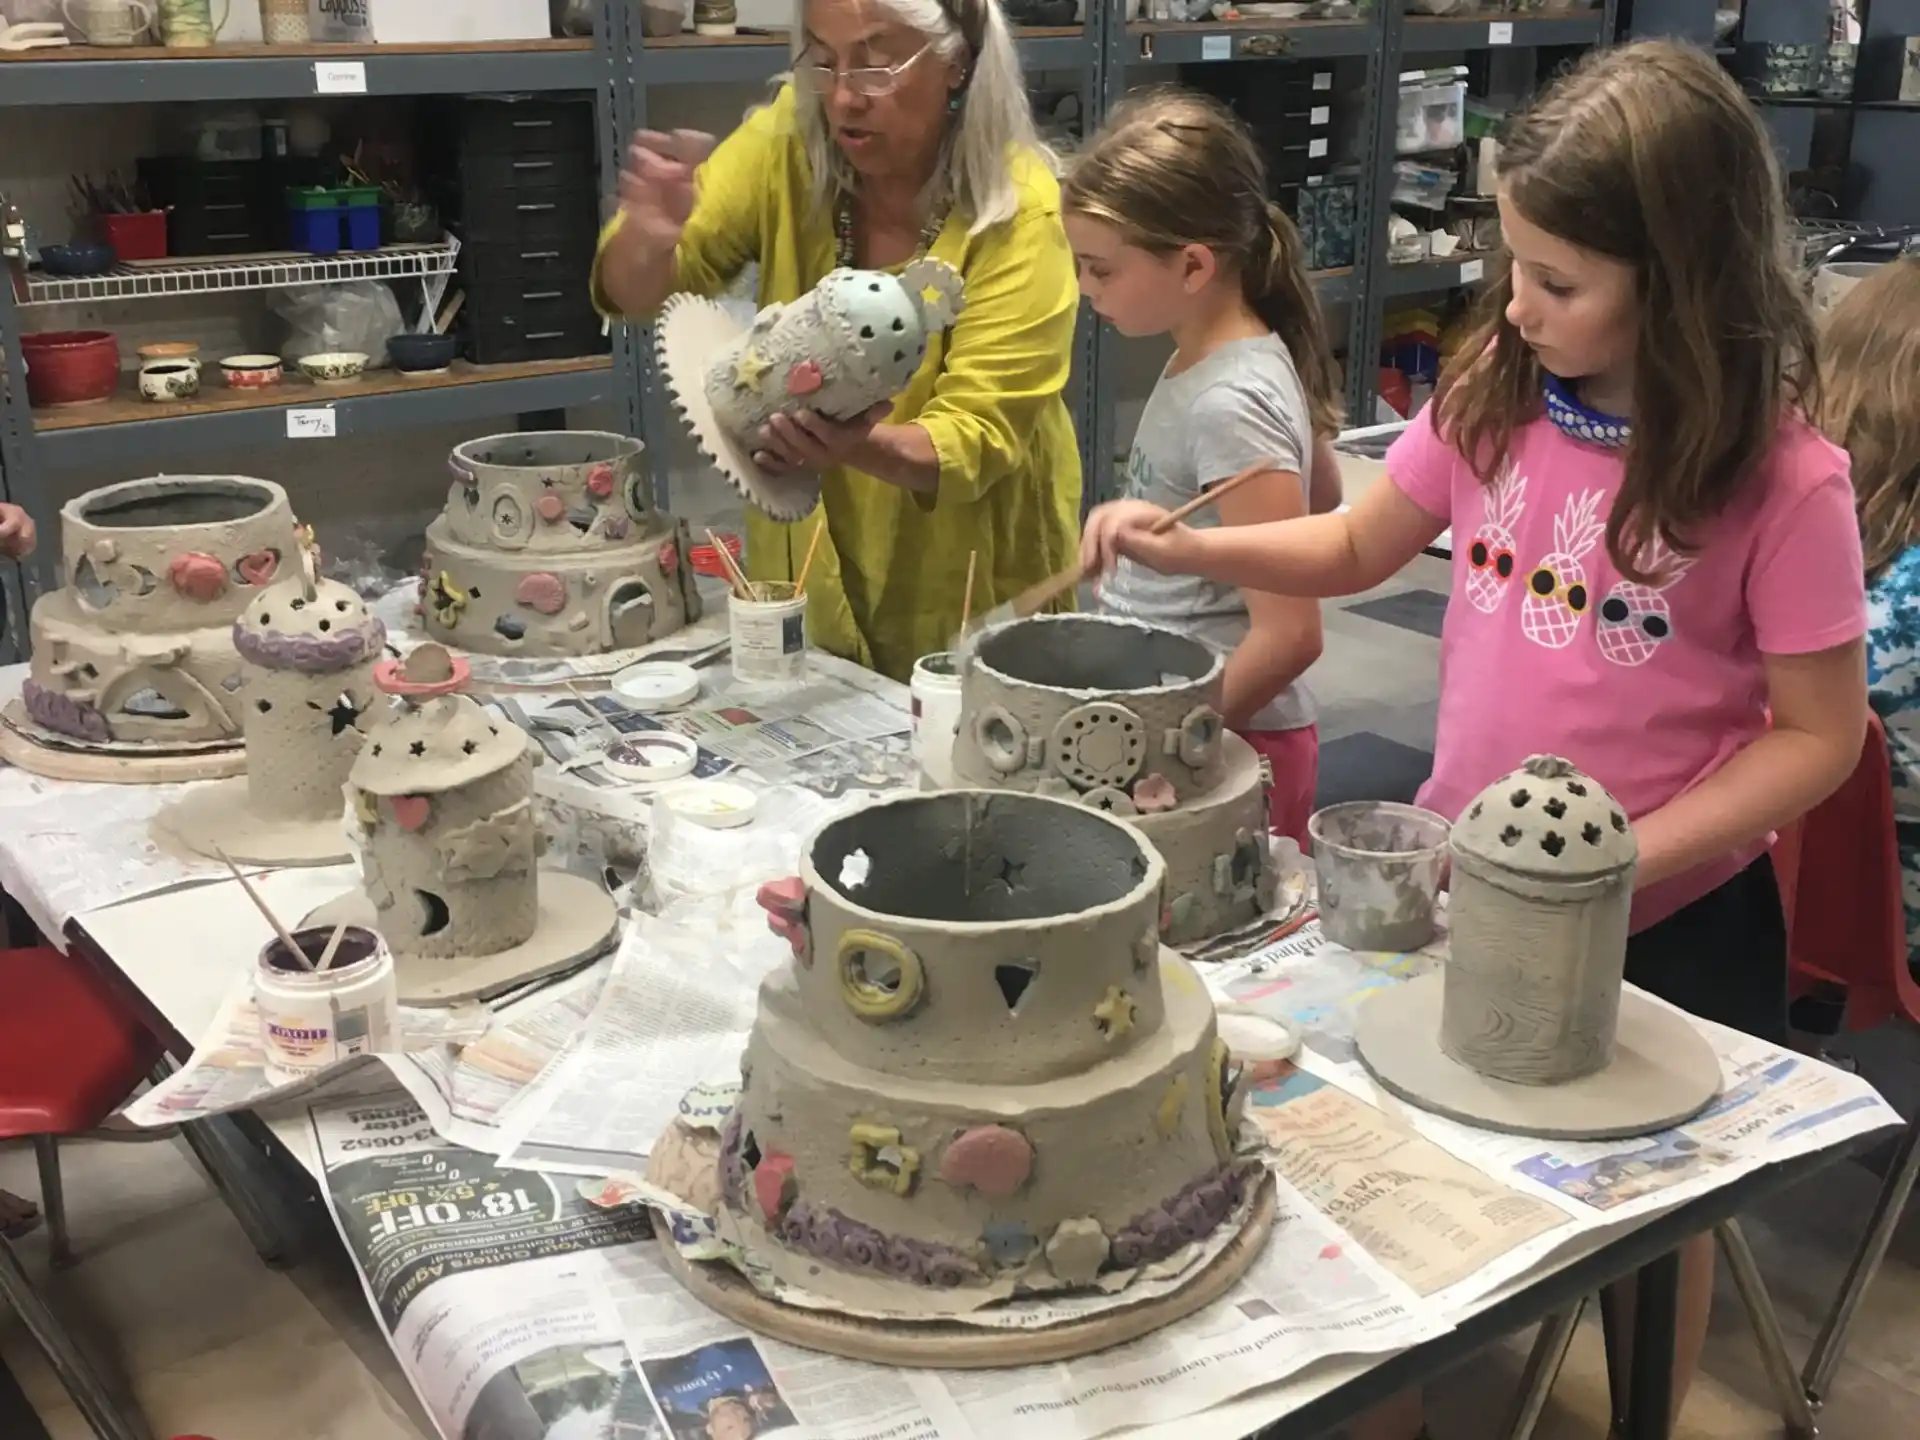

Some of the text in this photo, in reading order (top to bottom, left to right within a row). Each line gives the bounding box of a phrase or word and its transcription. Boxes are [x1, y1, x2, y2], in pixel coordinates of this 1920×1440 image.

[362, 1114, 429, 1131] utter
[365, 1192, 418, 1216] OFF
[428, 1186, 475, 1203] 5%
[466, 1188, 538, 1220] 18%
[369, 1202, 461, 1244] OFF
[538, 1241, 585, 1255] Your
[450, 1249, 531, 1268] Gutters
[391, 1262, 445, 1315] Again!
[1373, 1303, 1406, 1319] Man
[1156, 1356, 1212, 1384] charged
[1139, 1377, 1156, 1388] in
